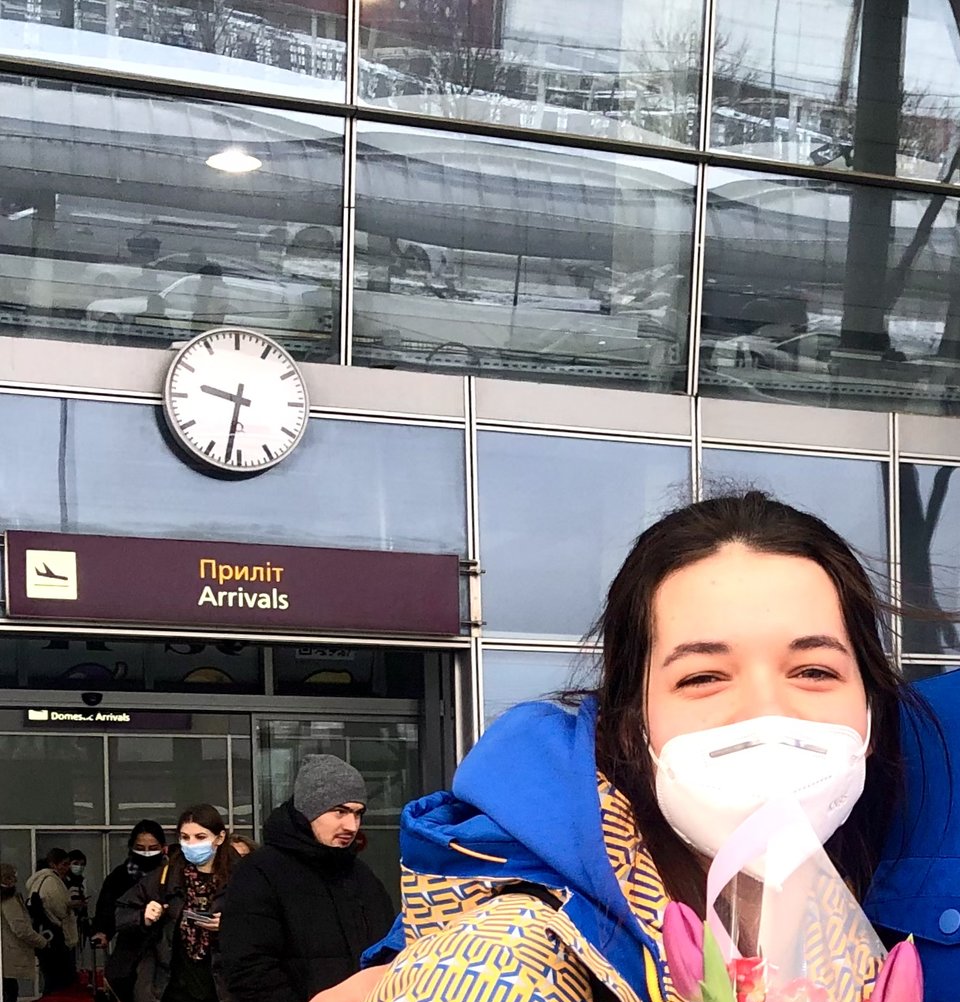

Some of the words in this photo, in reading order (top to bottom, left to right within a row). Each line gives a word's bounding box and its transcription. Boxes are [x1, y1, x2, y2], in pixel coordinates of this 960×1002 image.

[199, 558, 284, 585] Приліт
[197, 585, 290, 610] Arrivals
[95, 712, 131, 722] Arrivals
